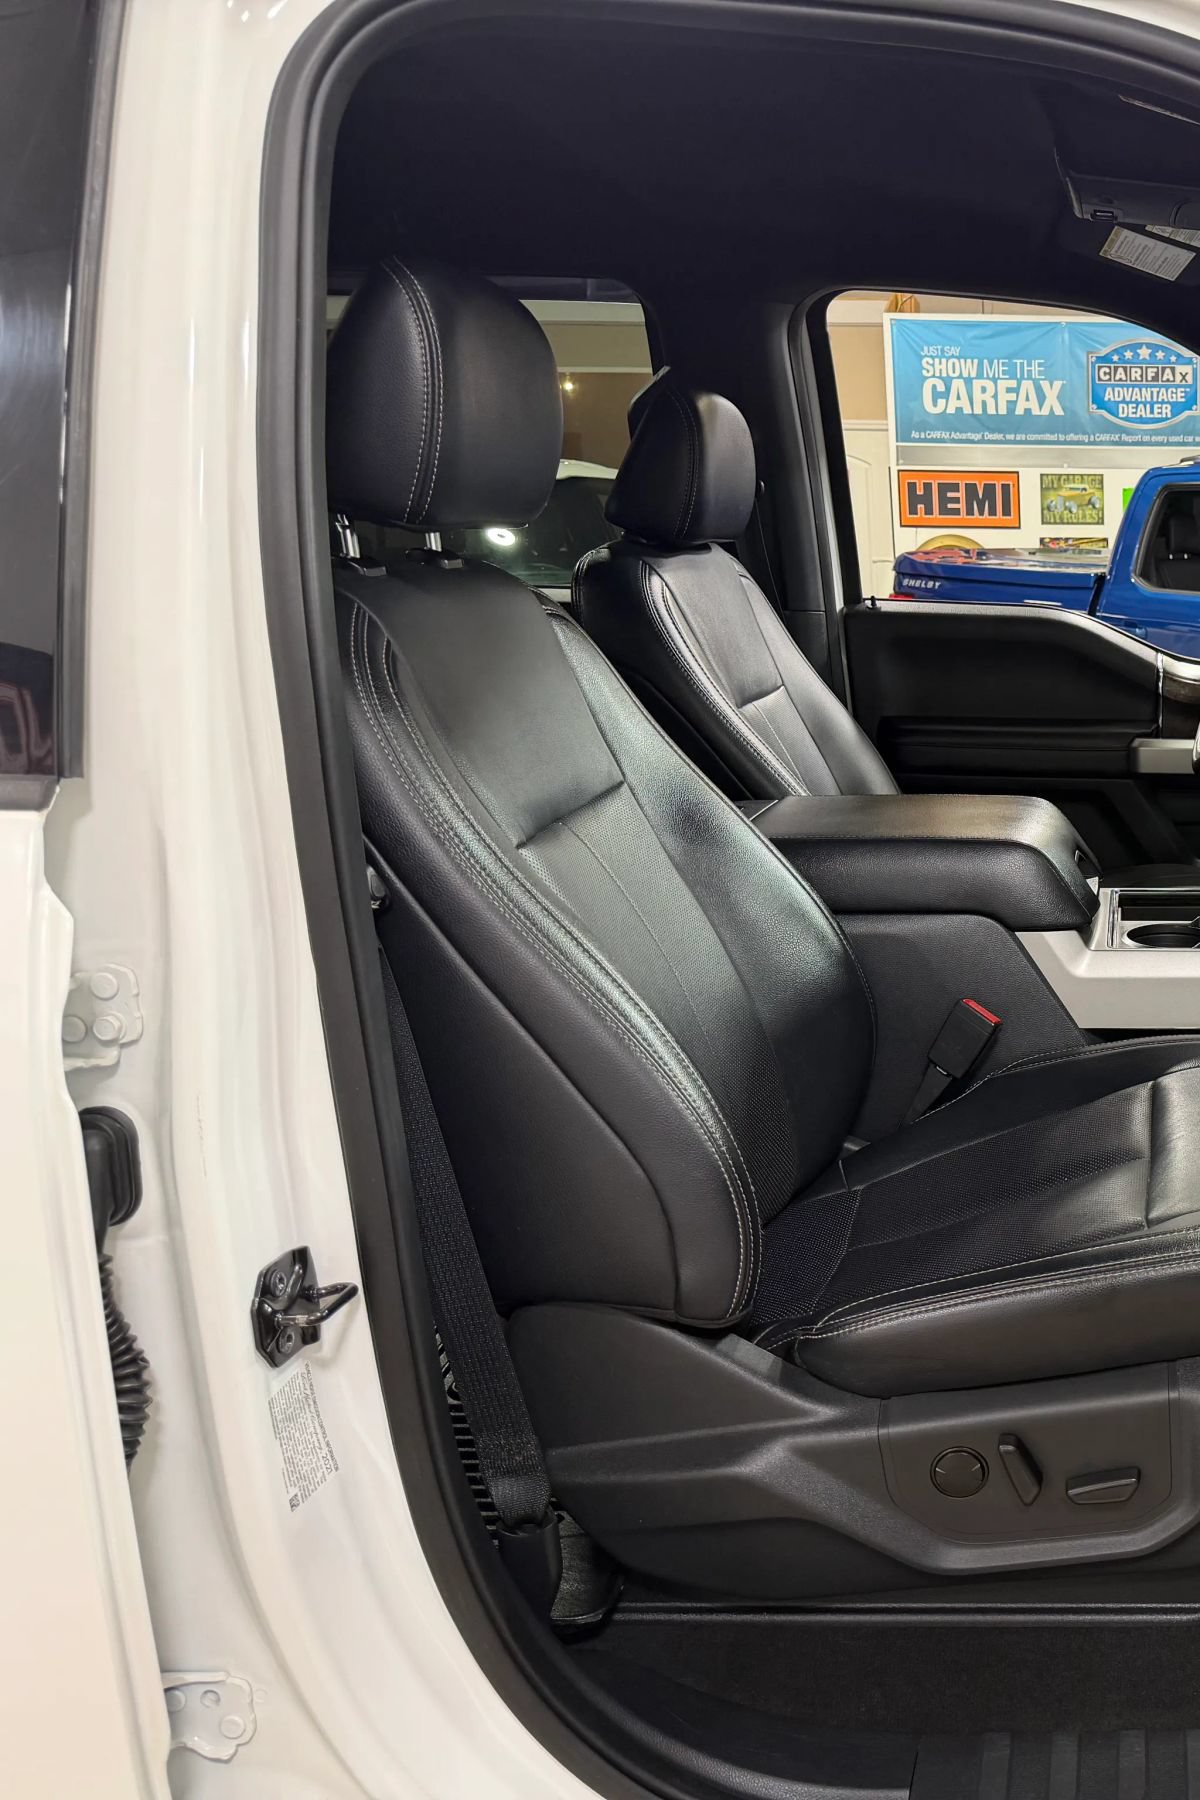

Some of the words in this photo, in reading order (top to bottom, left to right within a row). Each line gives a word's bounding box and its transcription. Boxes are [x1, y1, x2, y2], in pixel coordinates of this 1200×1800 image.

[921, 345, 943, 356] JUST
[944, 345, 961, 356] SAY
[922, 358, 979, 378] SHOW
[983, 359, 1009, 378] ME
[1012, 359, 1045, 379] THE
[1097, 365, 1192, 384] CARFAX
[922, 380, 1065, 416] CARFAX
[1118, 403, 1172, 418] DEALER
[1042, 474, 1059, 489] MY
[1060, 474, 1102, 489] GARAGE
[907, 480, 1013, 518] HEMI
[1043, 510, 1062, 524] MY
[1063, 510, 1103, 525] RULES!
[902, 578, 941, 590] SHELBY
[321, 1453, 333, 1476] 2021
